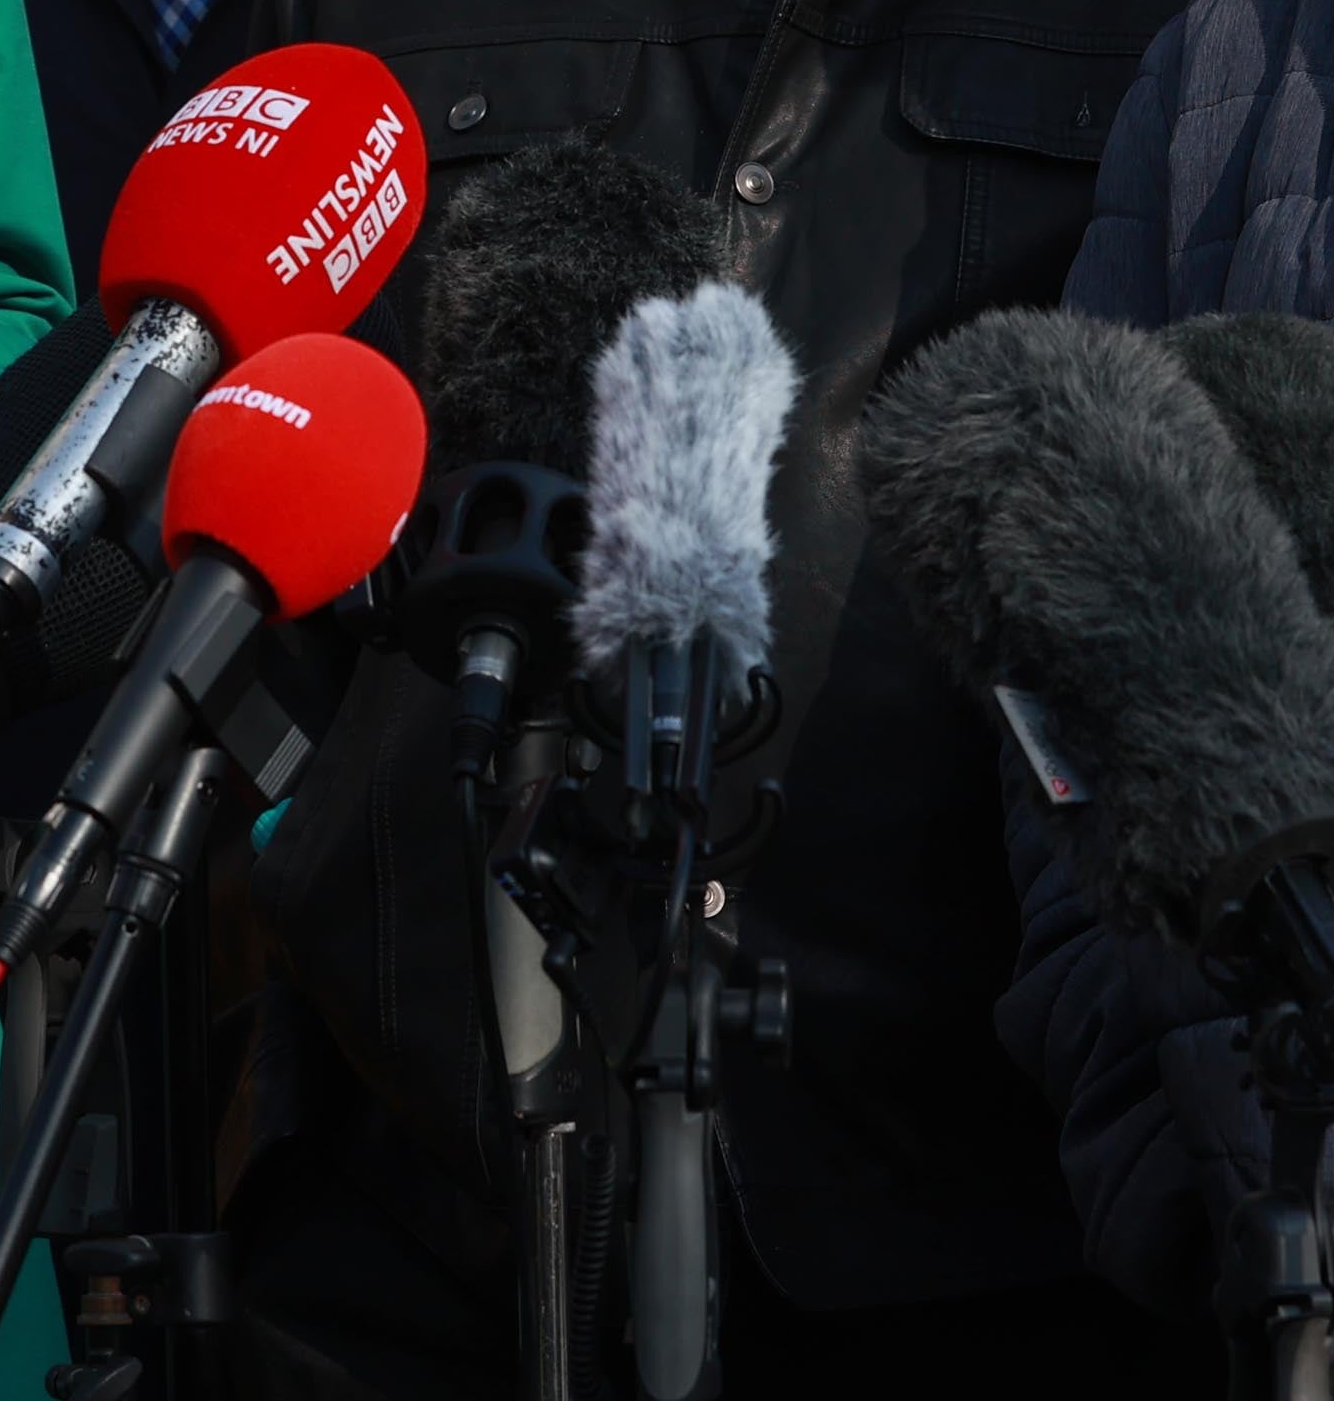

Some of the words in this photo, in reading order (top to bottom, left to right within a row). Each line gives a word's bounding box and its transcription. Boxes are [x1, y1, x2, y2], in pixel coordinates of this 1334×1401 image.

[147, 121, 234, 153] NEWS
[235, 127, 279, 158] NI
[169, 86, 307, 129] BBC
[266, 103, 404, 286] NEWSLINE
[324, 170, 407, 293] BBC
